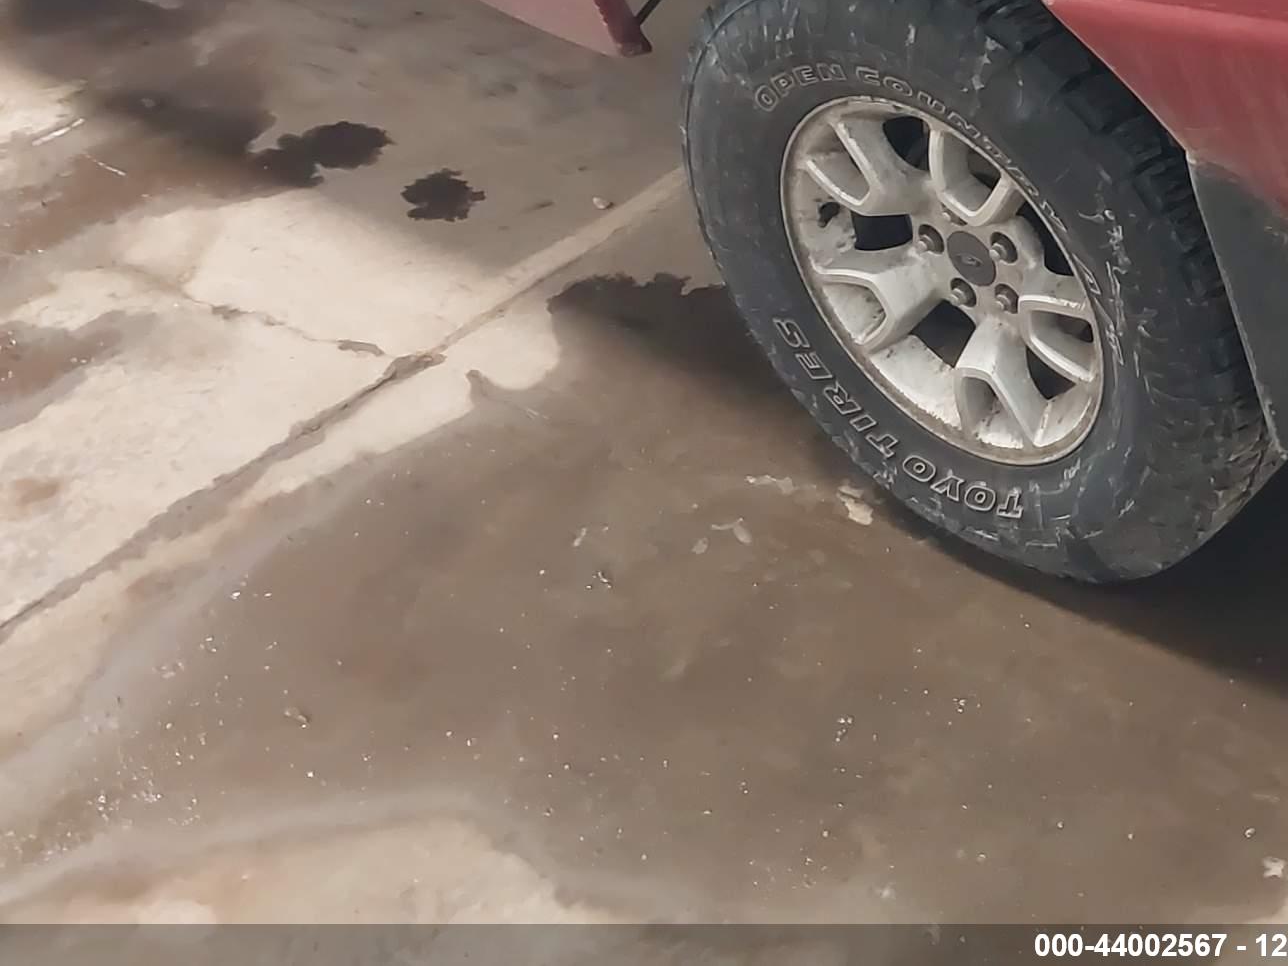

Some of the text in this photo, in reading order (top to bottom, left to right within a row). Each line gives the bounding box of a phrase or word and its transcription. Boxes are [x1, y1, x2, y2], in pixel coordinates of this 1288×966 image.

[755, 62, 847, 112] OPEN
[855, 66, 1067, 233] COUNTRY
[772, 317, 1025, 519] TOYO TIRES
